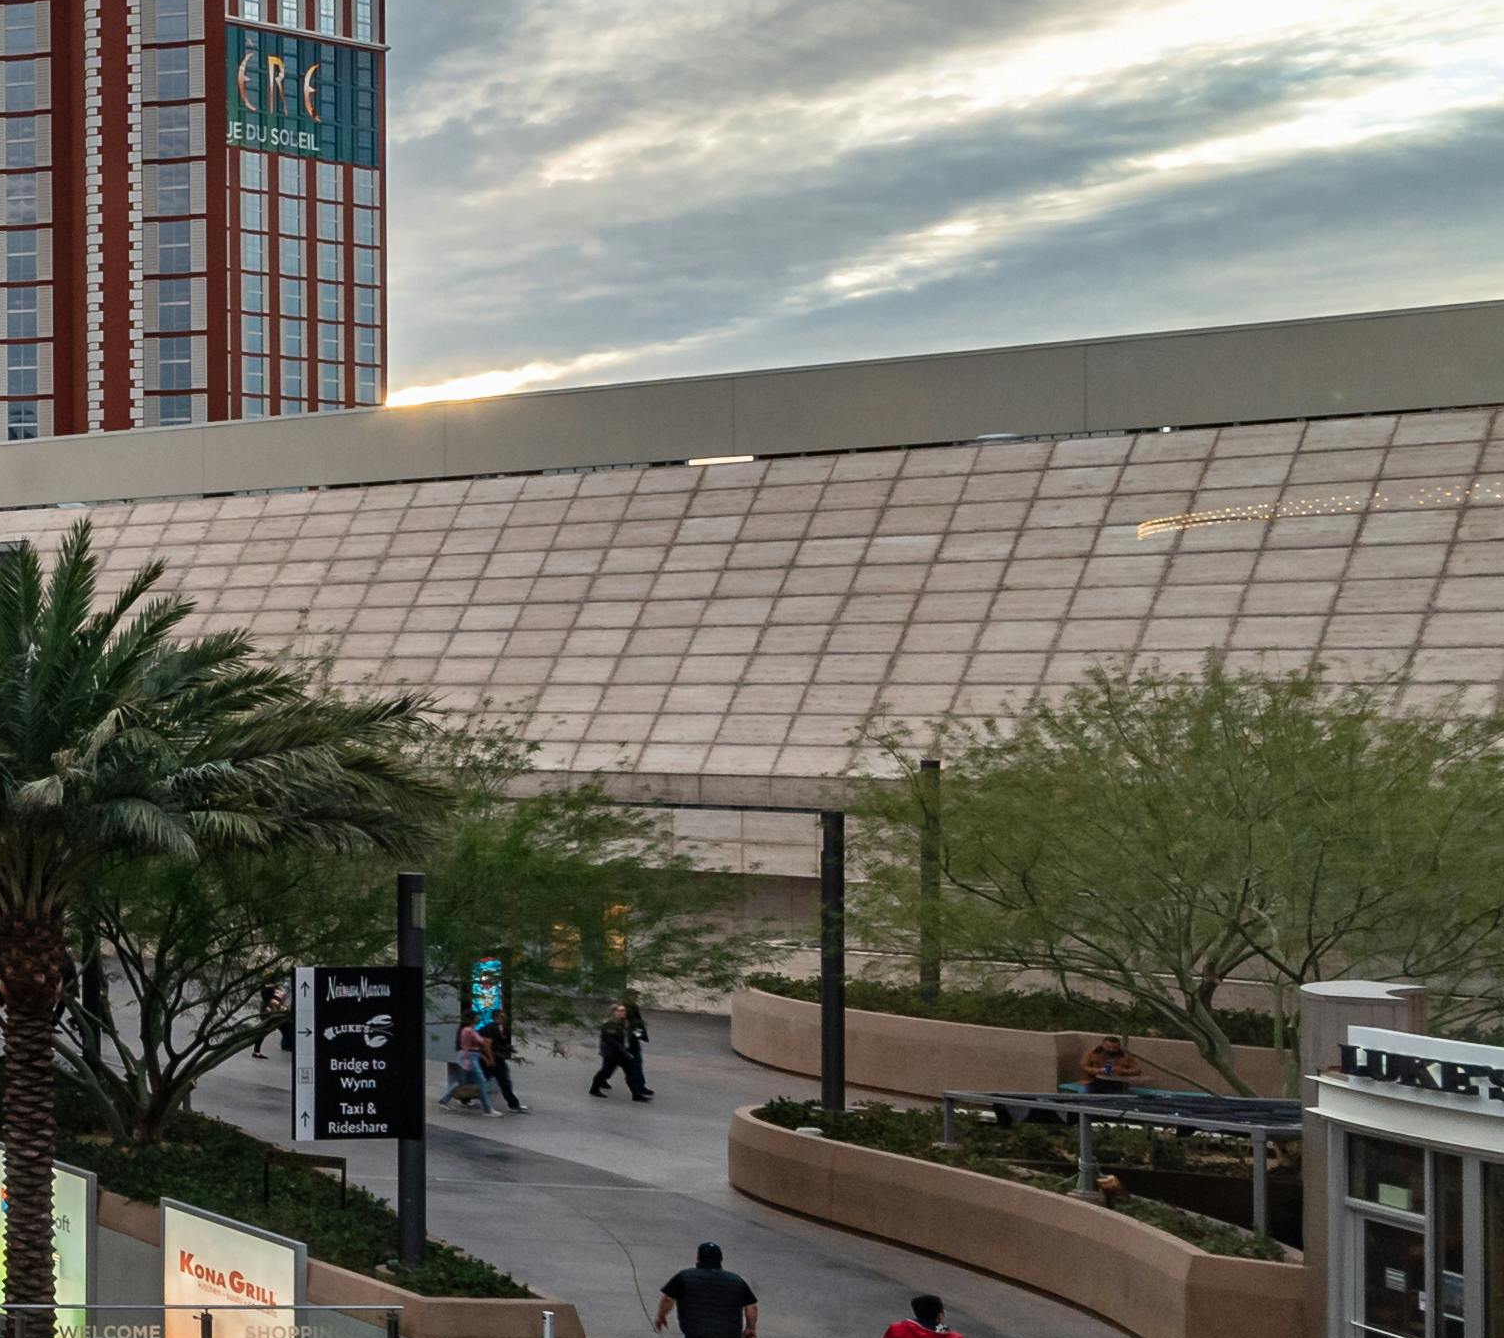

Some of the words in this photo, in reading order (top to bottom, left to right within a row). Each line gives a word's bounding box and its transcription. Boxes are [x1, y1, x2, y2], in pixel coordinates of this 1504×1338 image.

[246, 123, 267, 143] DU
[271, 128, 320, 151] SOLEIL
[330, 1058, 369, 1074] Bridge
[372, 1059, 386, 1070] to
[340, 1078, 376, 1092] Wynn
[340, 1103, 364, 1114] Taxi
[367, 1103, 376, 1114] &
[328, 1122, 388, 1134] Rideshare
